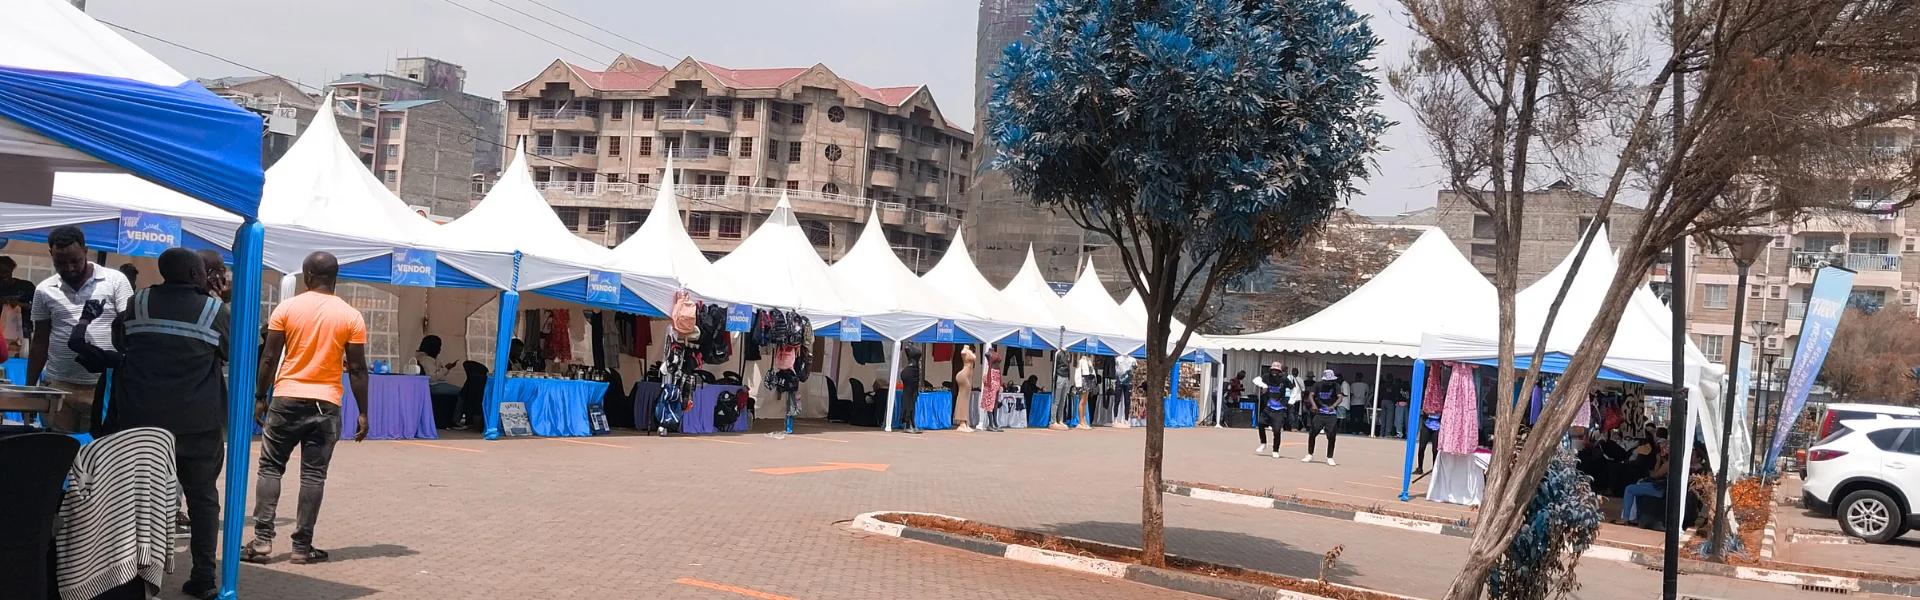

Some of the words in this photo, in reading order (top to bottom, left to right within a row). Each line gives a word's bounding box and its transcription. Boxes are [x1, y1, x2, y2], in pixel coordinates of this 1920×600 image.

[126, 230, 175, 244] VENDOR
[397, 263, 431, 275] VENDOR
[591, 283, 617, 293] VENDOR
